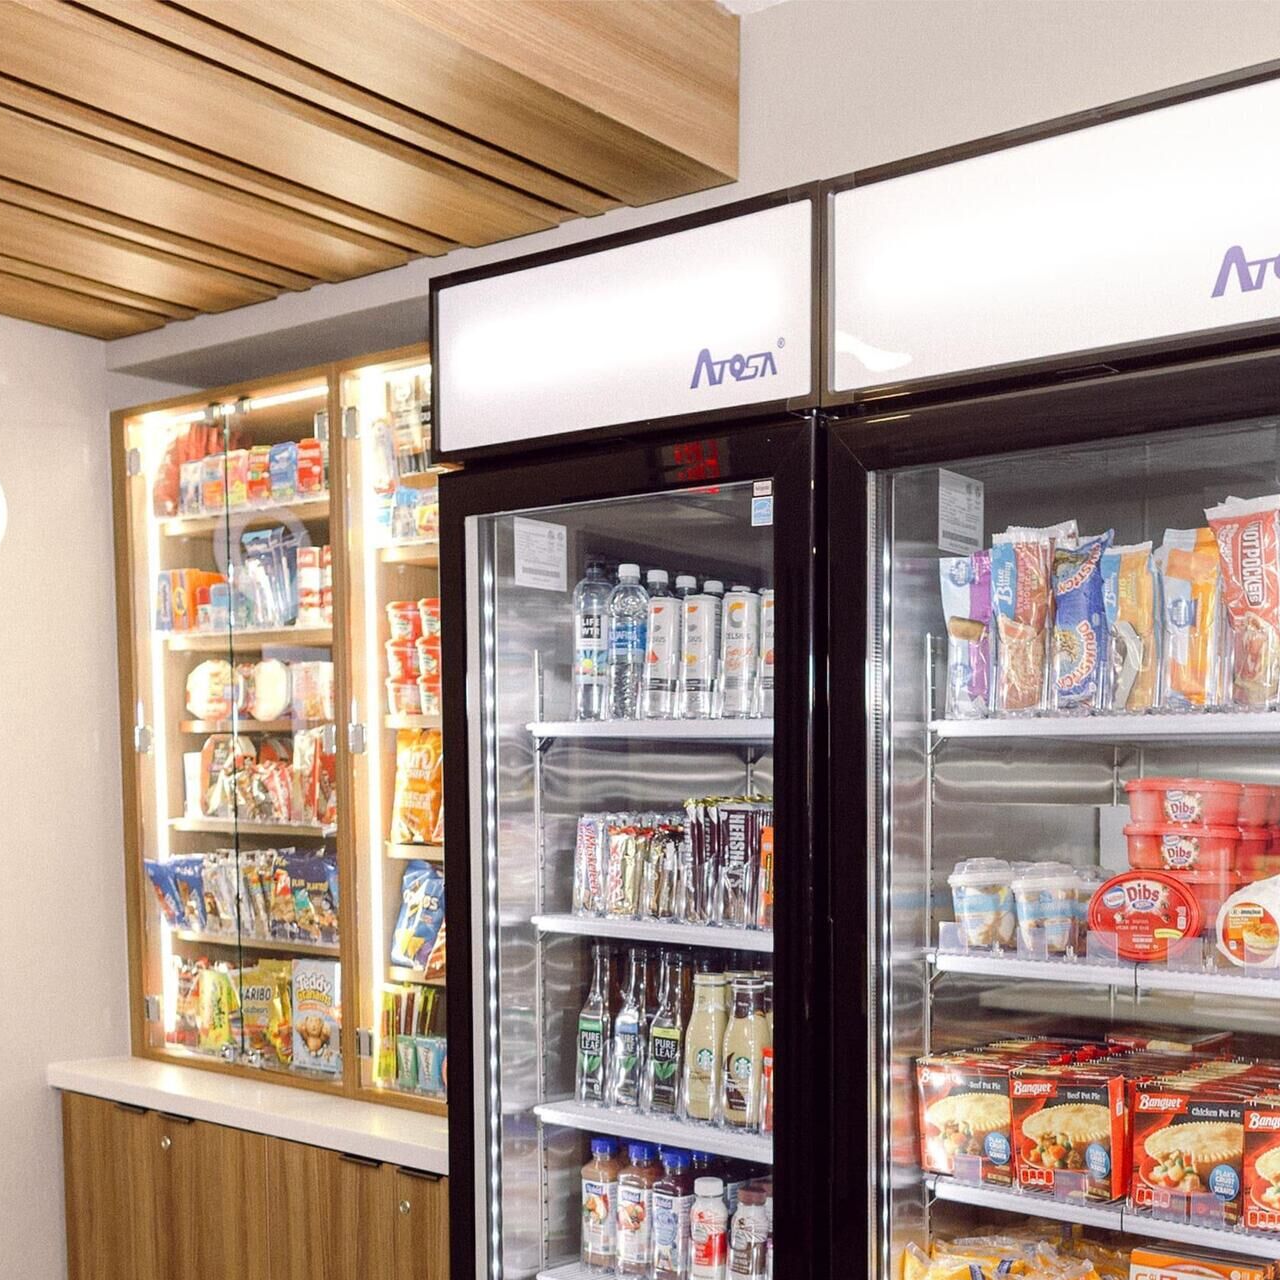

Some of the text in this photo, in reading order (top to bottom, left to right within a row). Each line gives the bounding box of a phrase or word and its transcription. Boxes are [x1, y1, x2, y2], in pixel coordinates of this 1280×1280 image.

[1057, 620, 1096, 689] DRUMSTICK
[1170, 801, 1196, 814] Dibs
[1166, 845, 1192, 859] Dibs
[1126, 882, 1160, 902] Dibs
[296, 972, 332, 993] Teddy
[242, 987, 272, 1001] ARIBO
[582, 1031, 601, 1041] PURE
[582, 1040, 600, 1051] LEAF
[655, 1039, 676, 1050] PURE
[656, 1048, 676, 1058] LEAF
[1013, 1081, 1052, 1096] Banquet
[1139, 1094, 1183, 1110] Banquet
[1191, 1107, 1218, 1117] Chicken
[1218, 1109, 1229, 1117] Pot
